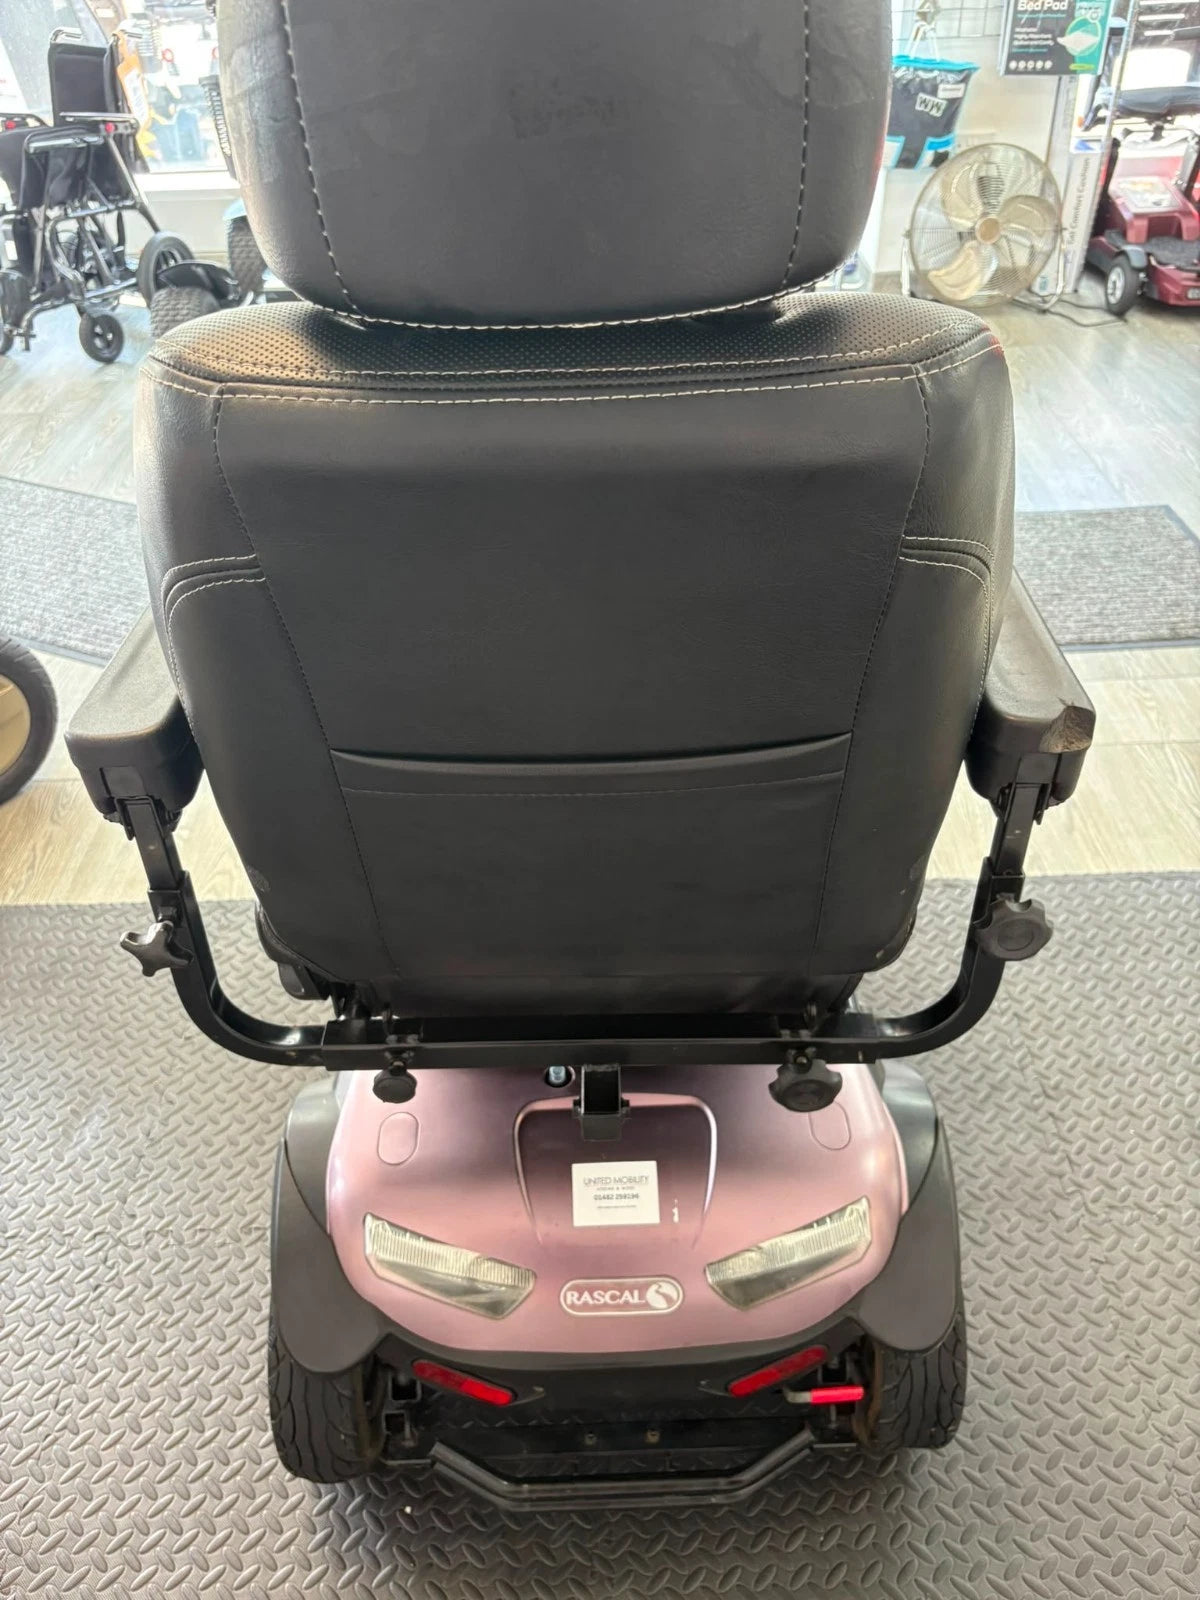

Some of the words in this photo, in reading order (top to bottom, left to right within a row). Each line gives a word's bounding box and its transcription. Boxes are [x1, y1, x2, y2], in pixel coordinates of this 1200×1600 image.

[1017, 0, 1043, 10] Bed
[1043, 0, 1068, 10] Pad
[583, 1177, 611, 1186] UNITED
[613, 1175, 649, 1185] MOBILITY
[566, 1289, 646, 1304] RASCAL
